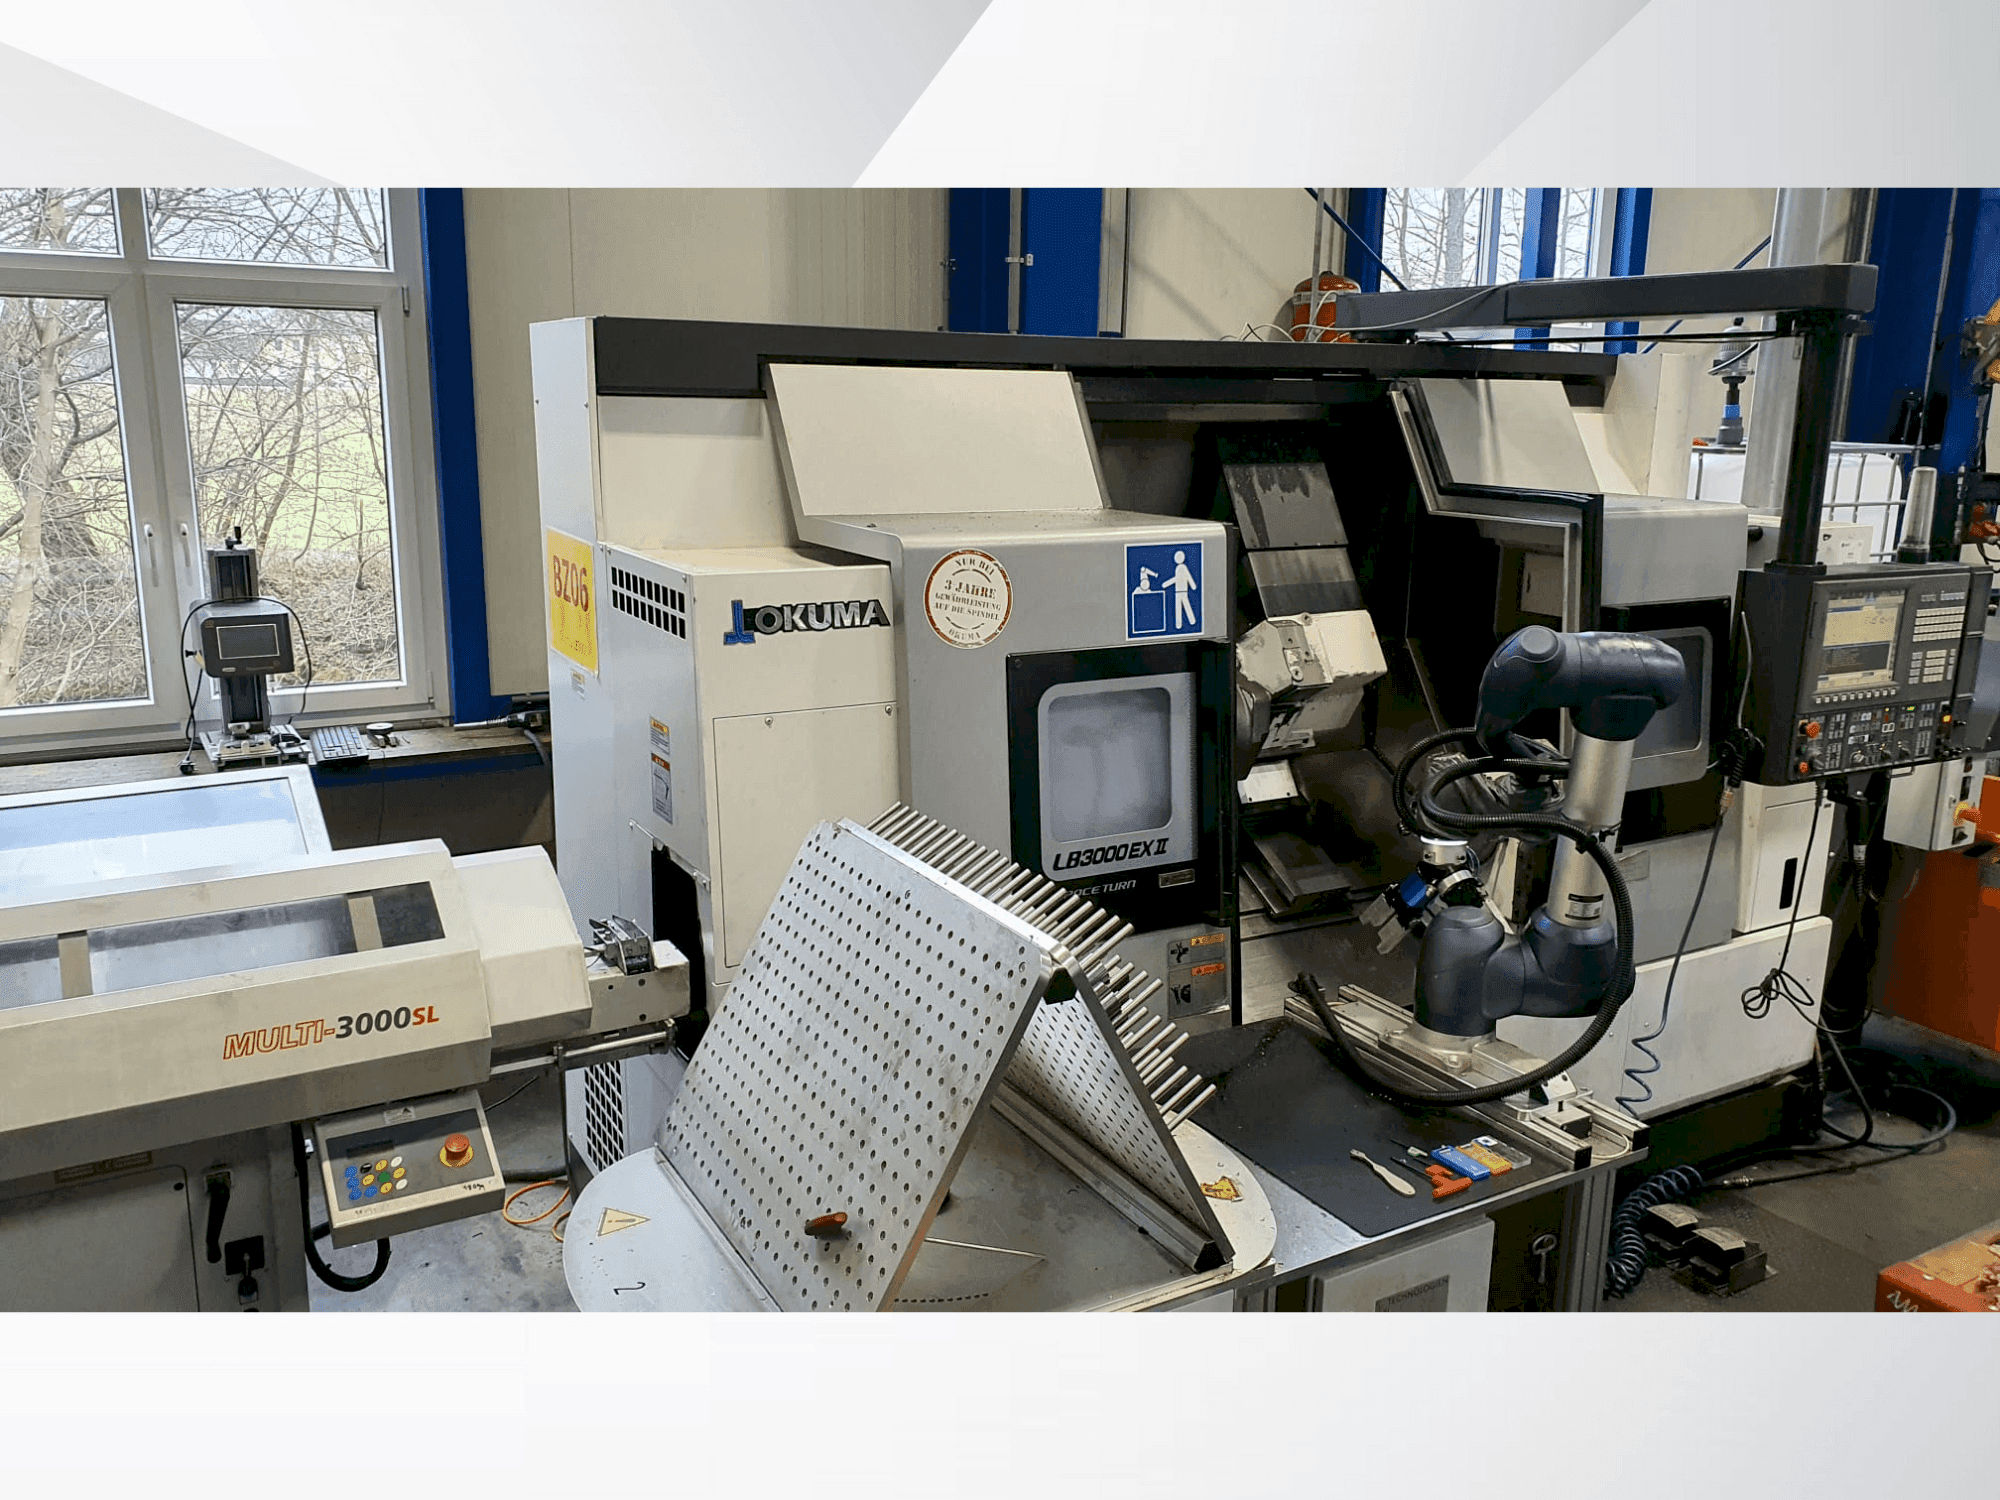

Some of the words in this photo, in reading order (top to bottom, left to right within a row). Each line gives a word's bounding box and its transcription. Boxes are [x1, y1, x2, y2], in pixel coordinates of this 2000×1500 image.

[955, 557, 976, 567] NUR
[553, 555, 589, 613] BZ06
[944, 579, 953, 591] 3
[955, 581, 997, 600] JAHRE
[754, 599, 891, 635] OKUMA
[934, 602, 949, 612] AUF
[951, 605, 965, 615] DIE
[967, 608, 1000, 622] SPINDEL
[1102, 879, 1137, 893] TURN
[222, 1005, 440, 1061] MULTI-3000SL
